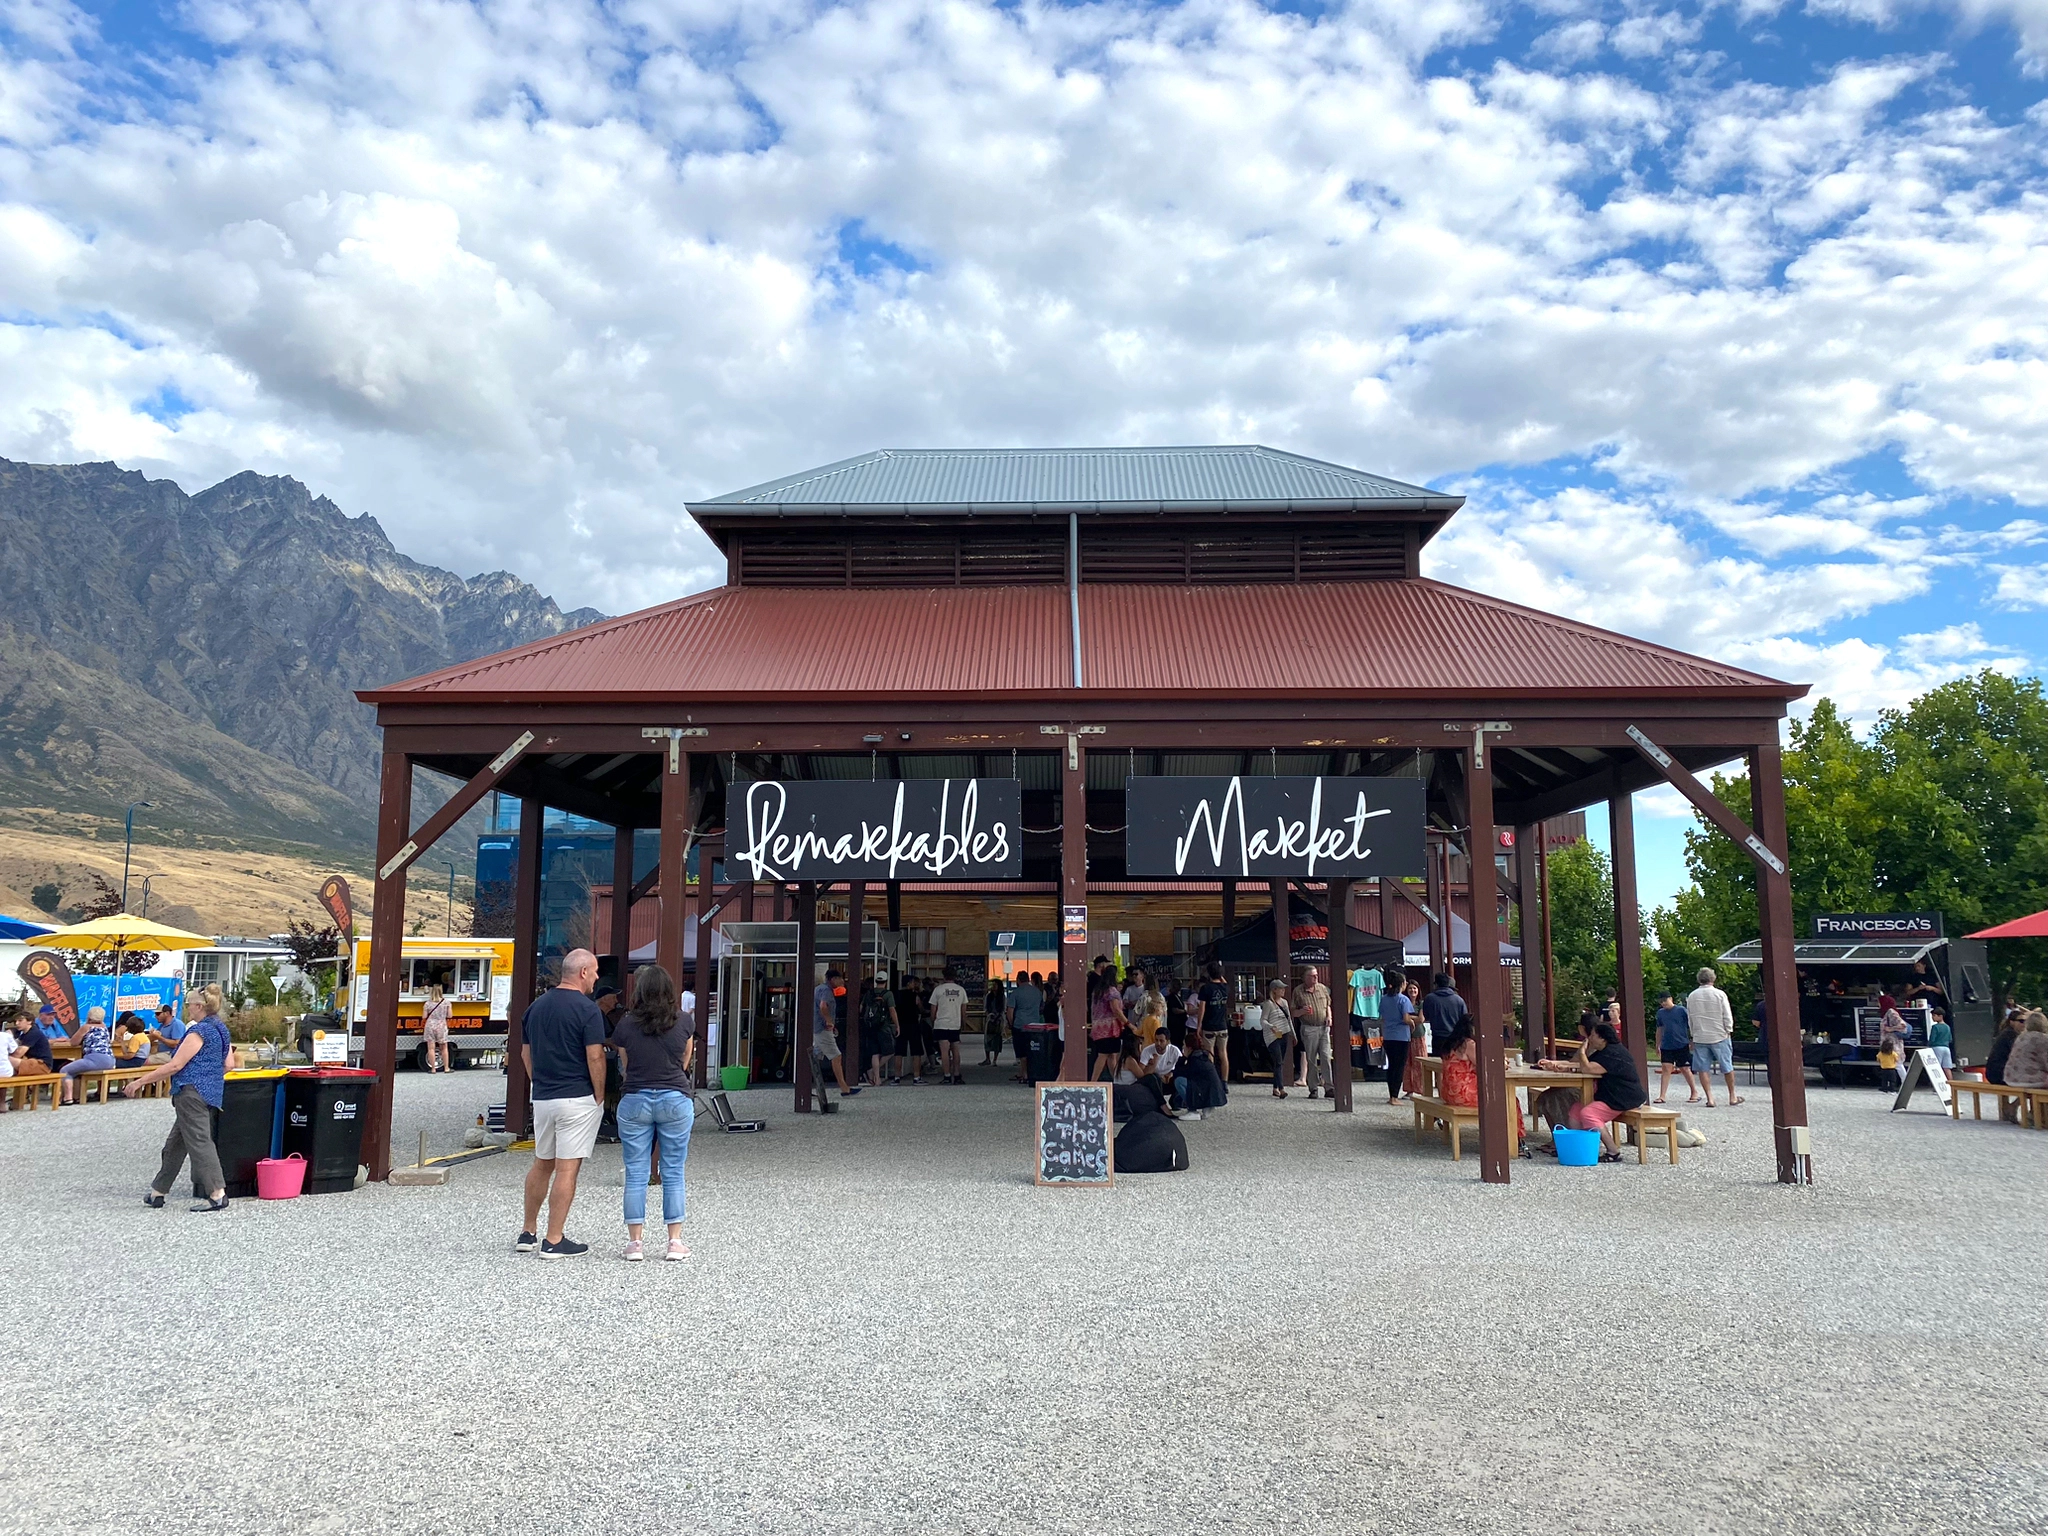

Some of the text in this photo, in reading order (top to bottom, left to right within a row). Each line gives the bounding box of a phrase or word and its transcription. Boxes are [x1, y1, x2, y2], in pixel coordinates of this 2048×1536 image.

[735, 778, 1010, 881] Remarkables
[1175, 776, 1392, 876] Market
[330, 892, 351, 930] WAFFLES
[1817, 917, 1931, 932] FRANCESCA'S
[39, 973, 76, 1025] WAFFLES
[1046, 1097, 1107, 1128] Enjoy
[1055, 1120, 1098, 1143] The
